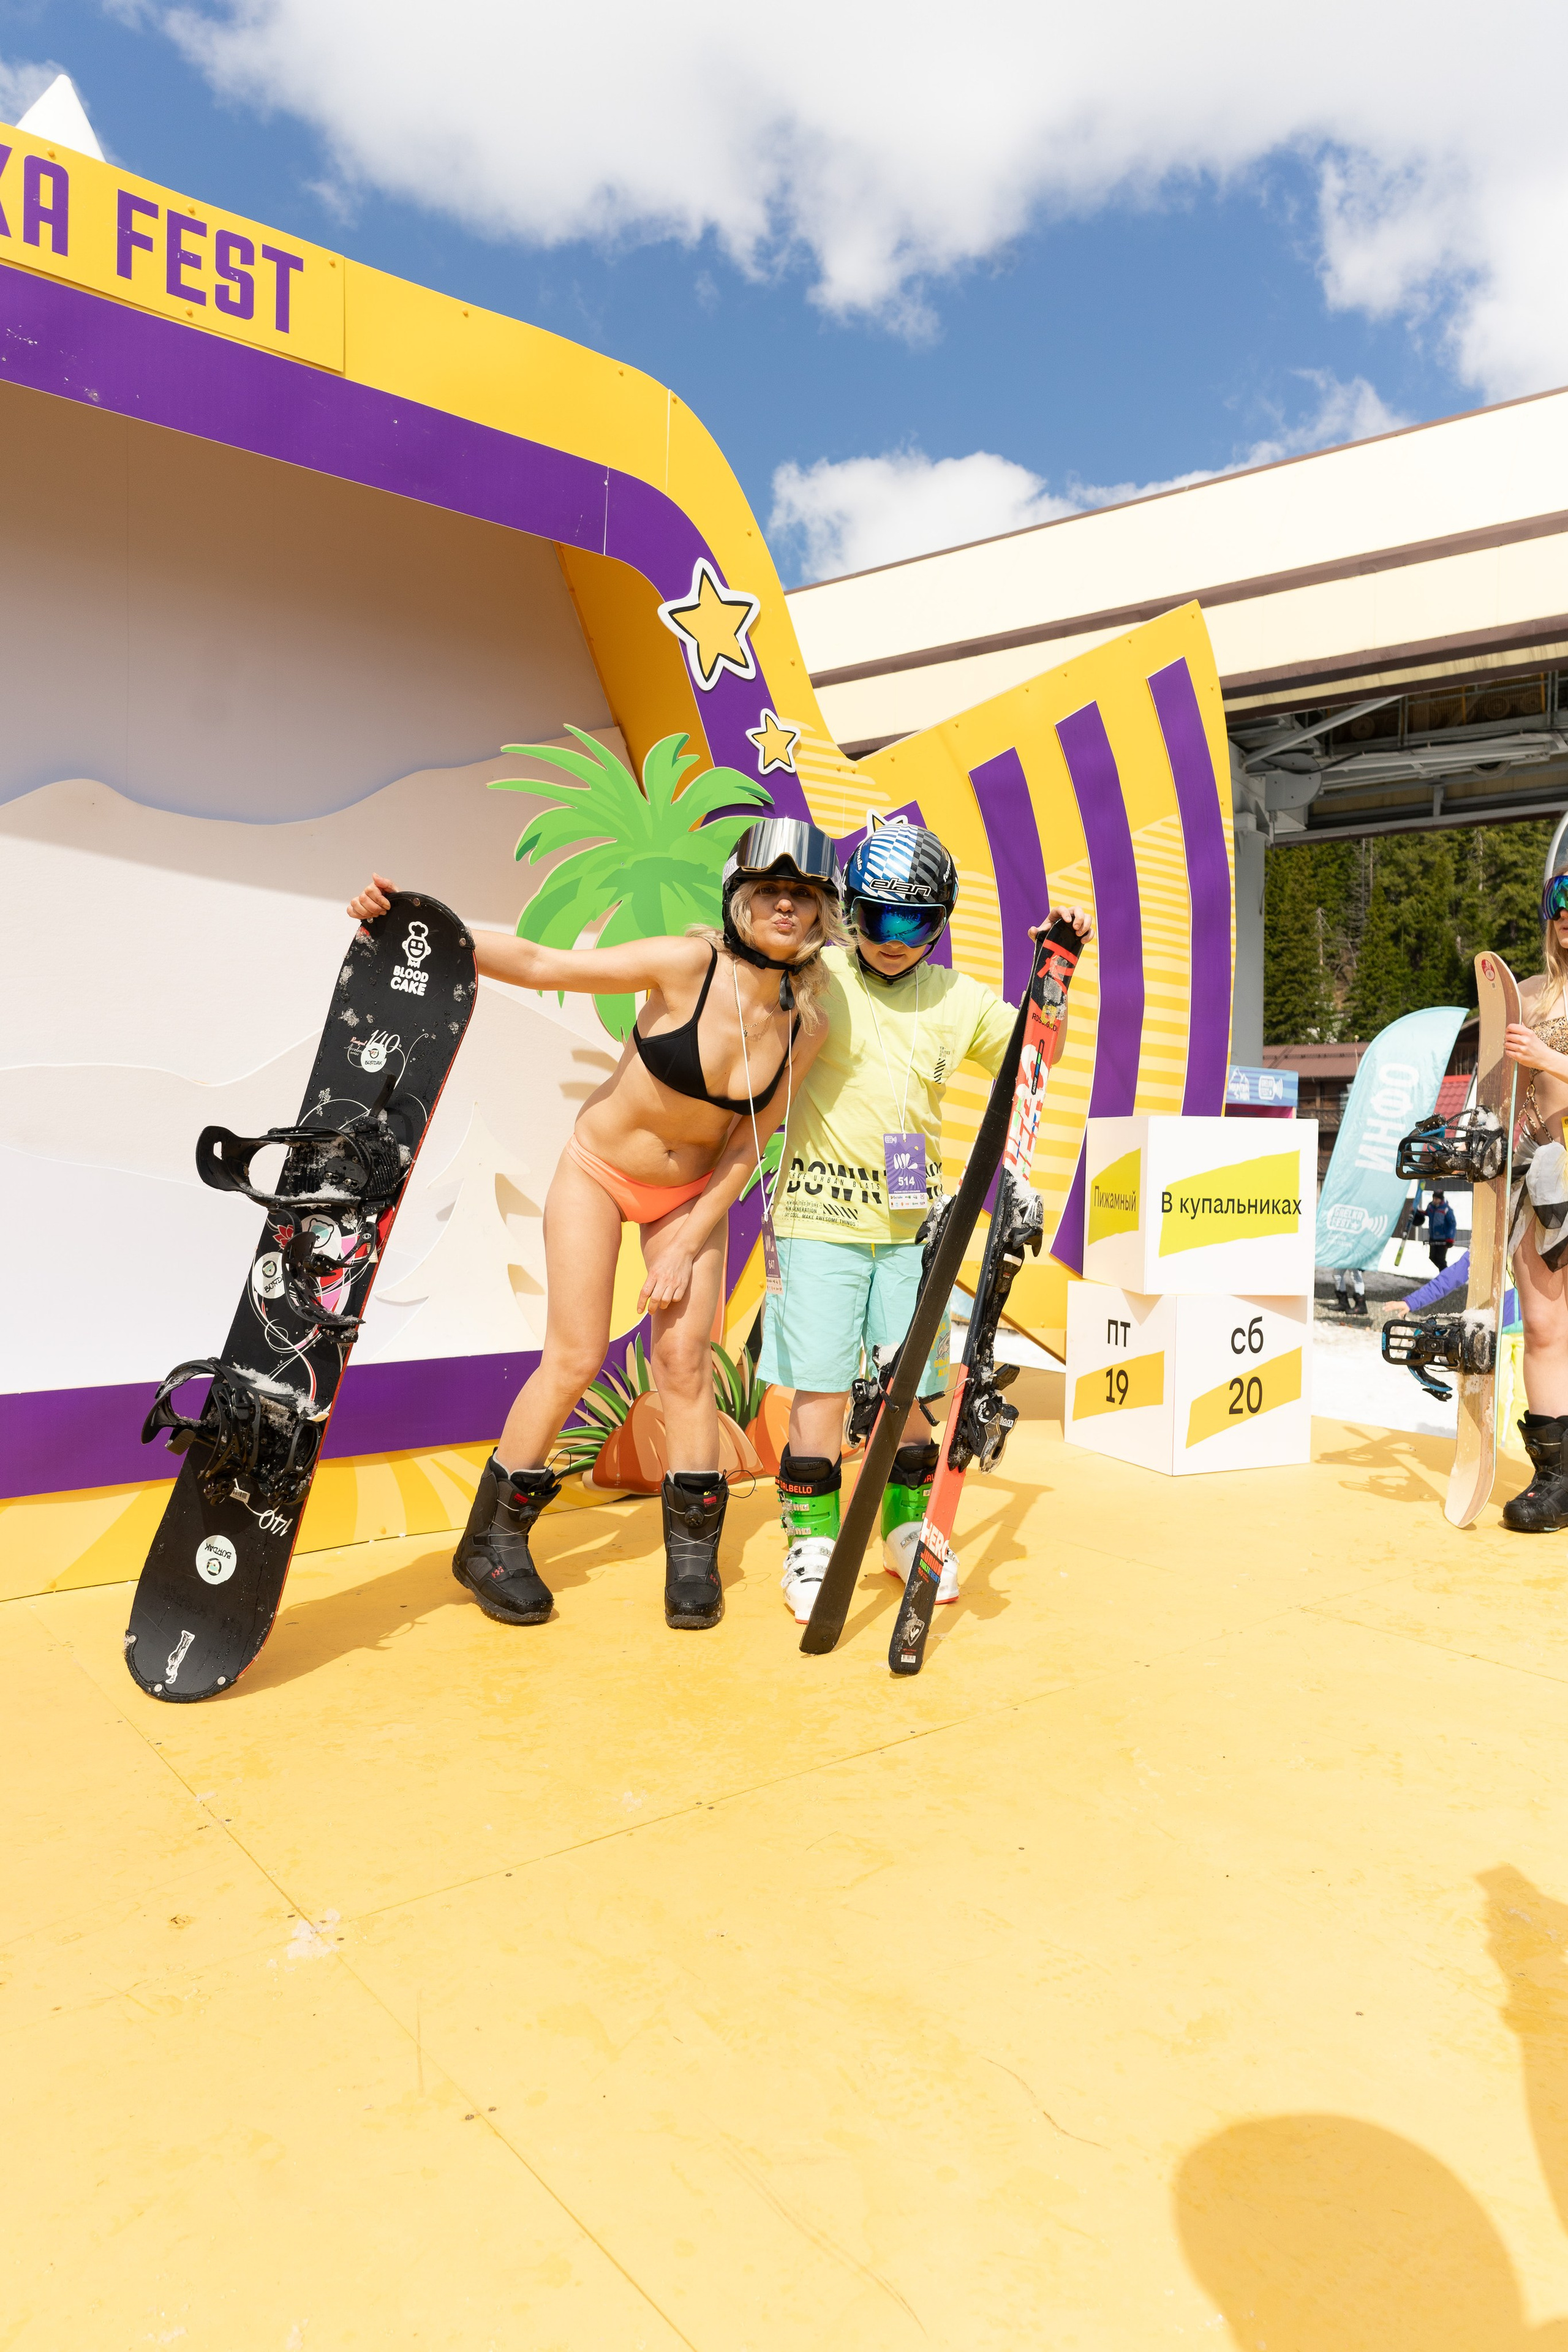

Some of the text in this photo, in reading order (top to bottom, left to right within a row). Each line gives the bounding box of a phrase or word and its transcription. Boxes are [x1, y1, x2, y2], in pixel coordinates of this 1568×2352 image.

[117, 189, 304, 334] FEST
[869, 878, 932, 897] elan
[390, 976, 427, 996] CAKE
[393, 965, 429, 982] BLOOD
[1354, 1062, 1419, 1174] ИНФО
[814, 1173, 844, 1186] URBAN
[853, 1181, 880, 1190] BEATS
[898, 1177, 915, 1186] 514
[1094, 1186, 1136, 1212] Пижамный
[1161, 1192, 1302, 1219] В купальниках
[1231, 1316, 1264, 1354] сб
[1106, 1368, 1129, 1405] 19
[1229, 1376, 1263, 1415] 20
[258, 1509, 293, 1537] 140
